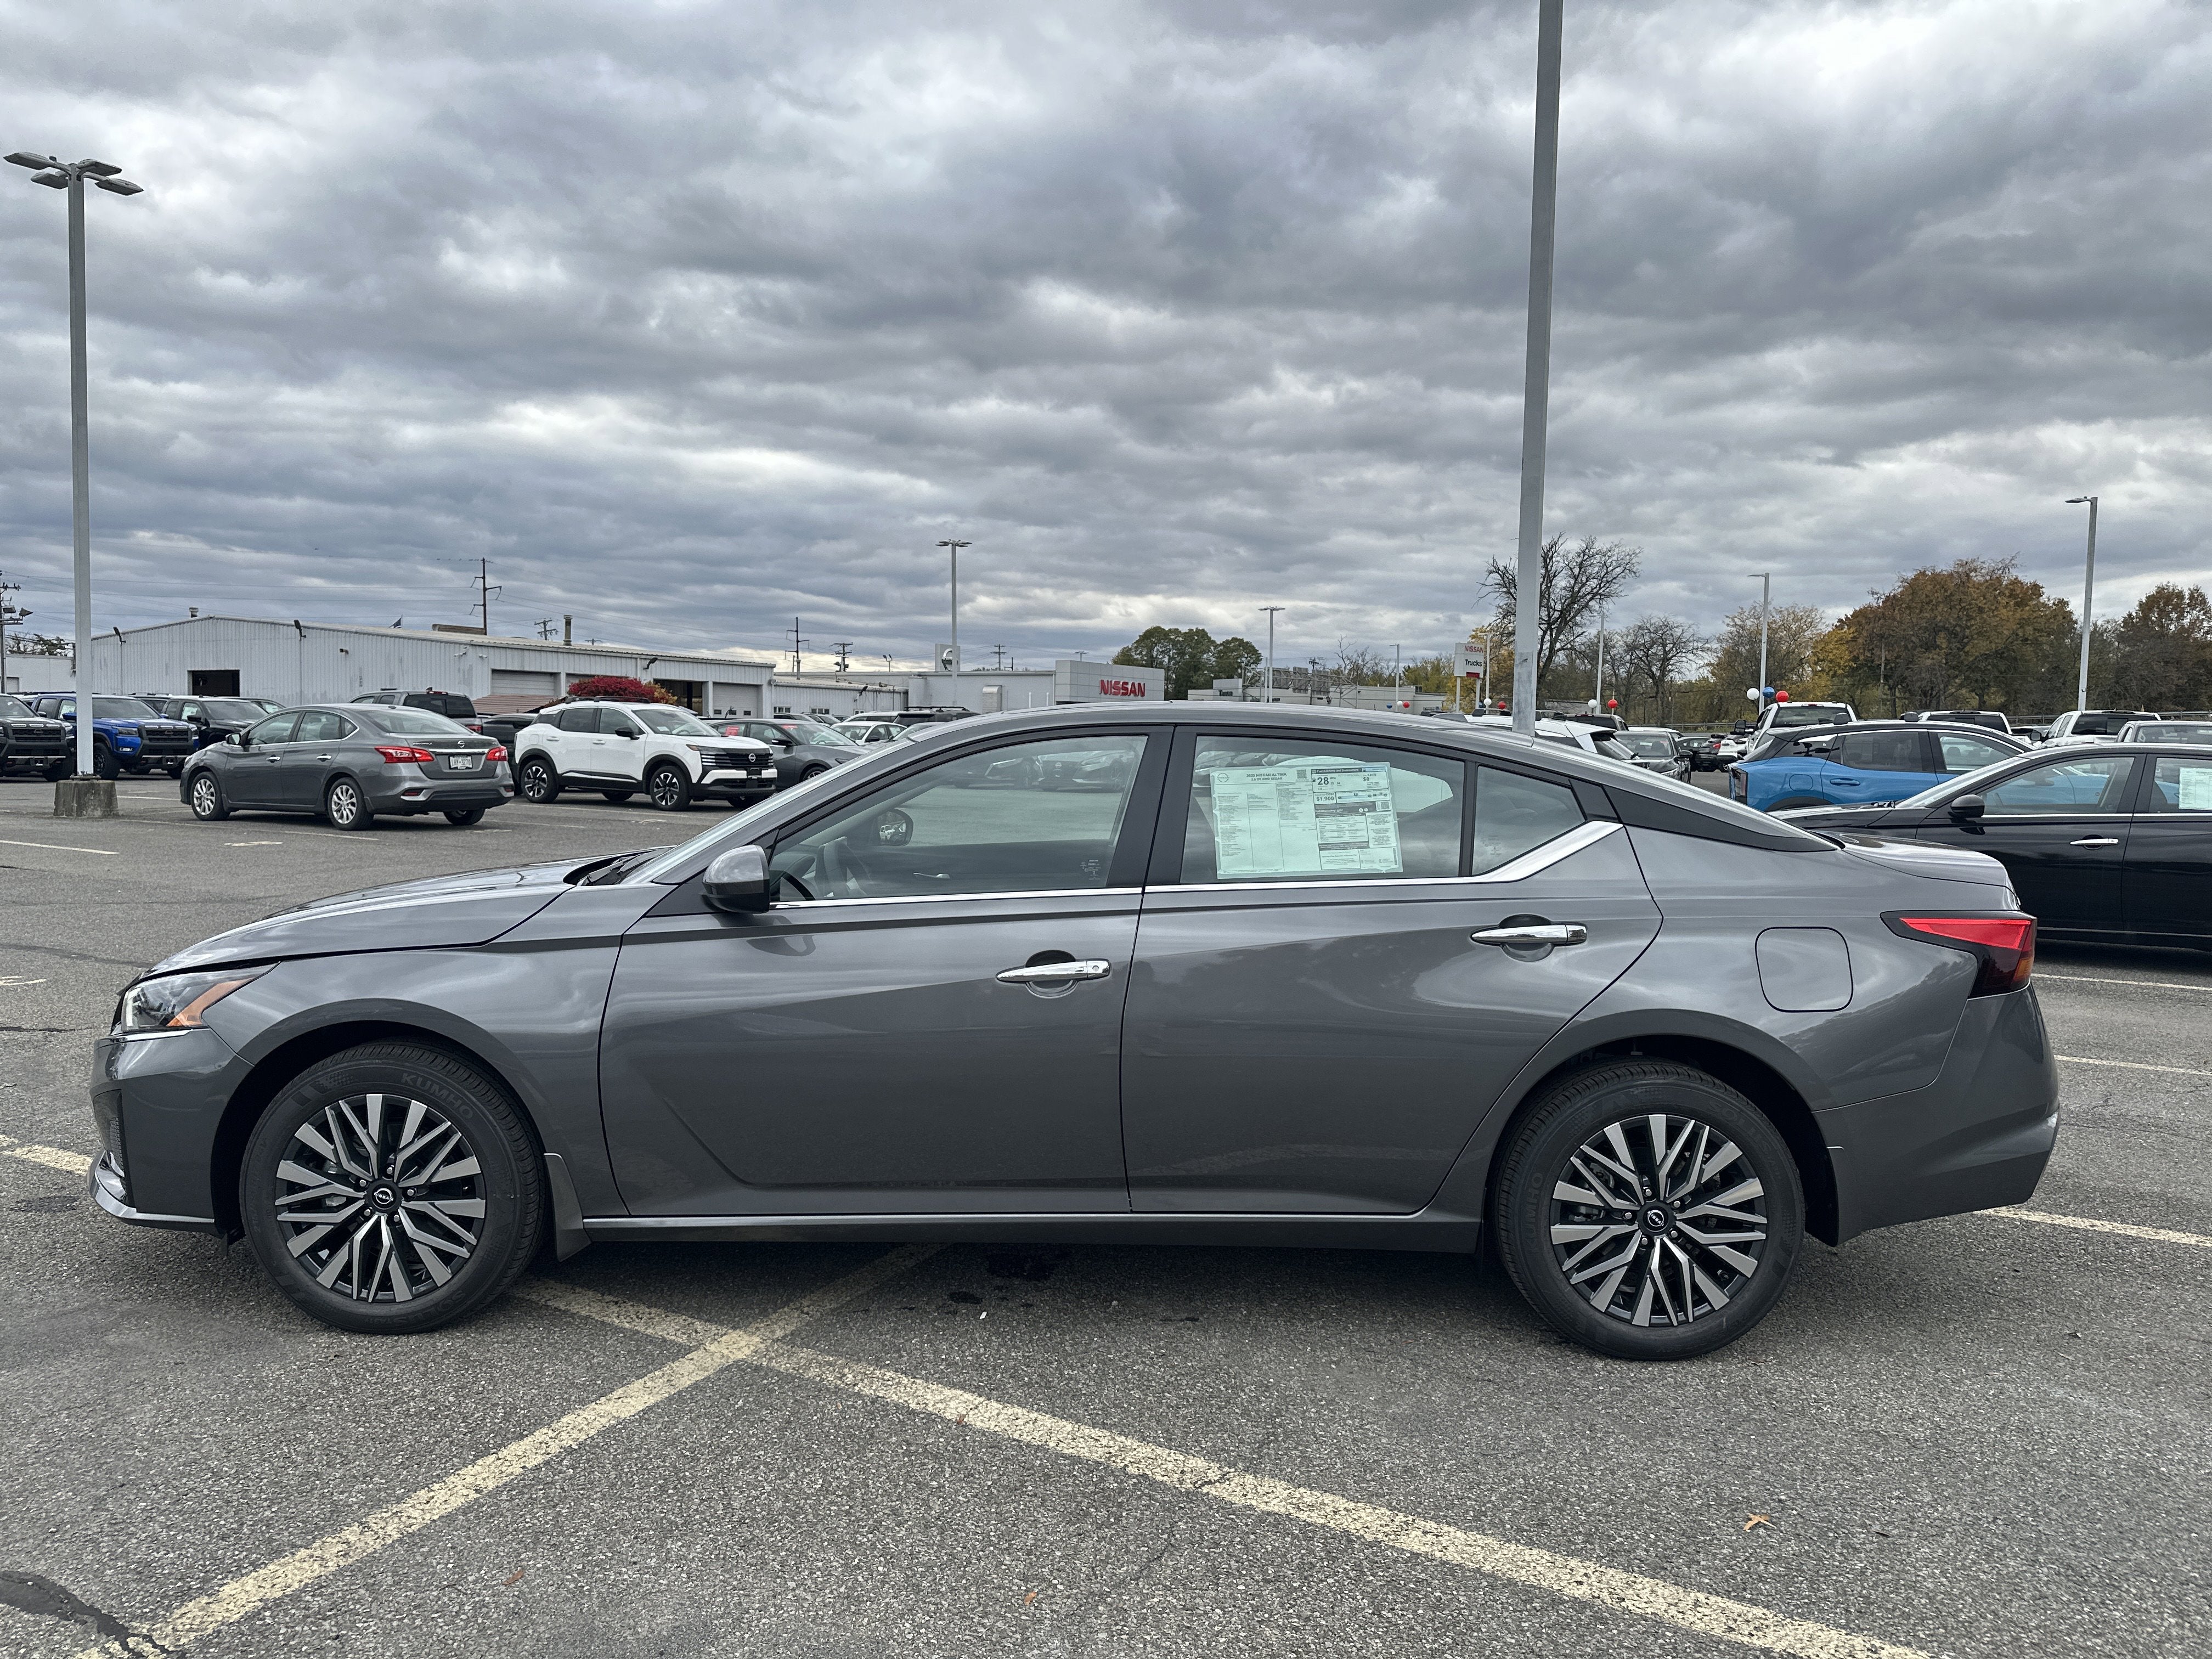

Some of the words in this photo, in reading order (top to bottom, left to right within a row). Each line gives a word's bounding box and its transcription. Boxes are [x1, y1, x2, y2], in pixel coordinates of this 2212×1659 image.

[1099, 679, 1146, 697] NISSAN
[1317, 777, 1329, 785] 28
[400, 1073, 473, 1119] KUMHO
